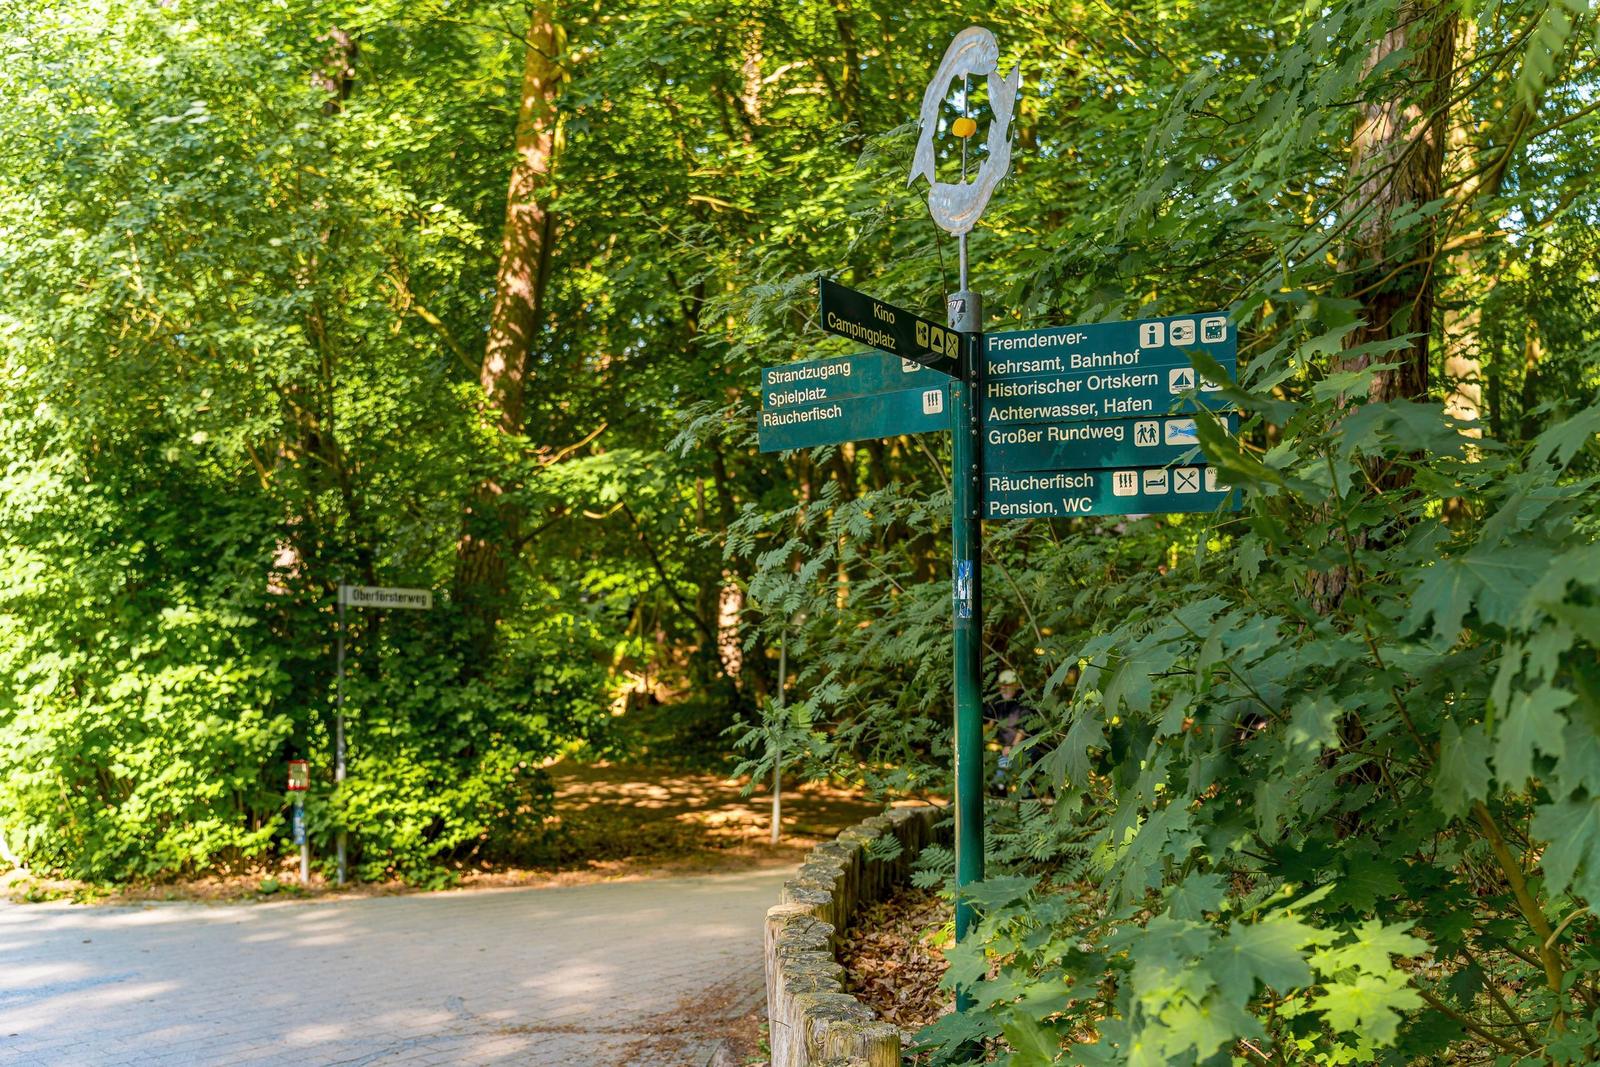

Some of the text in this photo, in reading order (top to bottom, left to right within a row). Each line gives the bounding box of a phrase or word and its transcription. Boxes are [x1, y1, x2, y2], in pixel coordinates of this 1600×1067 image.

[873, 302, 896, 325] Kino
[827, 311, 896, 350] Campingplatz
[988, 332, 1088, 351] Fremdenver-
[767, 361, 851, 385] Strandzugang
[988, 349, 1140, 375] kehrsamt, Bahnhof
[768, 387, 827, 407] Spielplatz
[988, 373, 1158, 398] Historischer Ortskern
[763, 404, 842, 428] Räucherfisch
[988, 397, 1153, 422] Achterwasser, Hafen
[988, 424, 1125, 444] Großer Rundweg
[989, 473, 1094, 492] Räucherfisch
[989, 498, 1093, 516] Pension, WC
